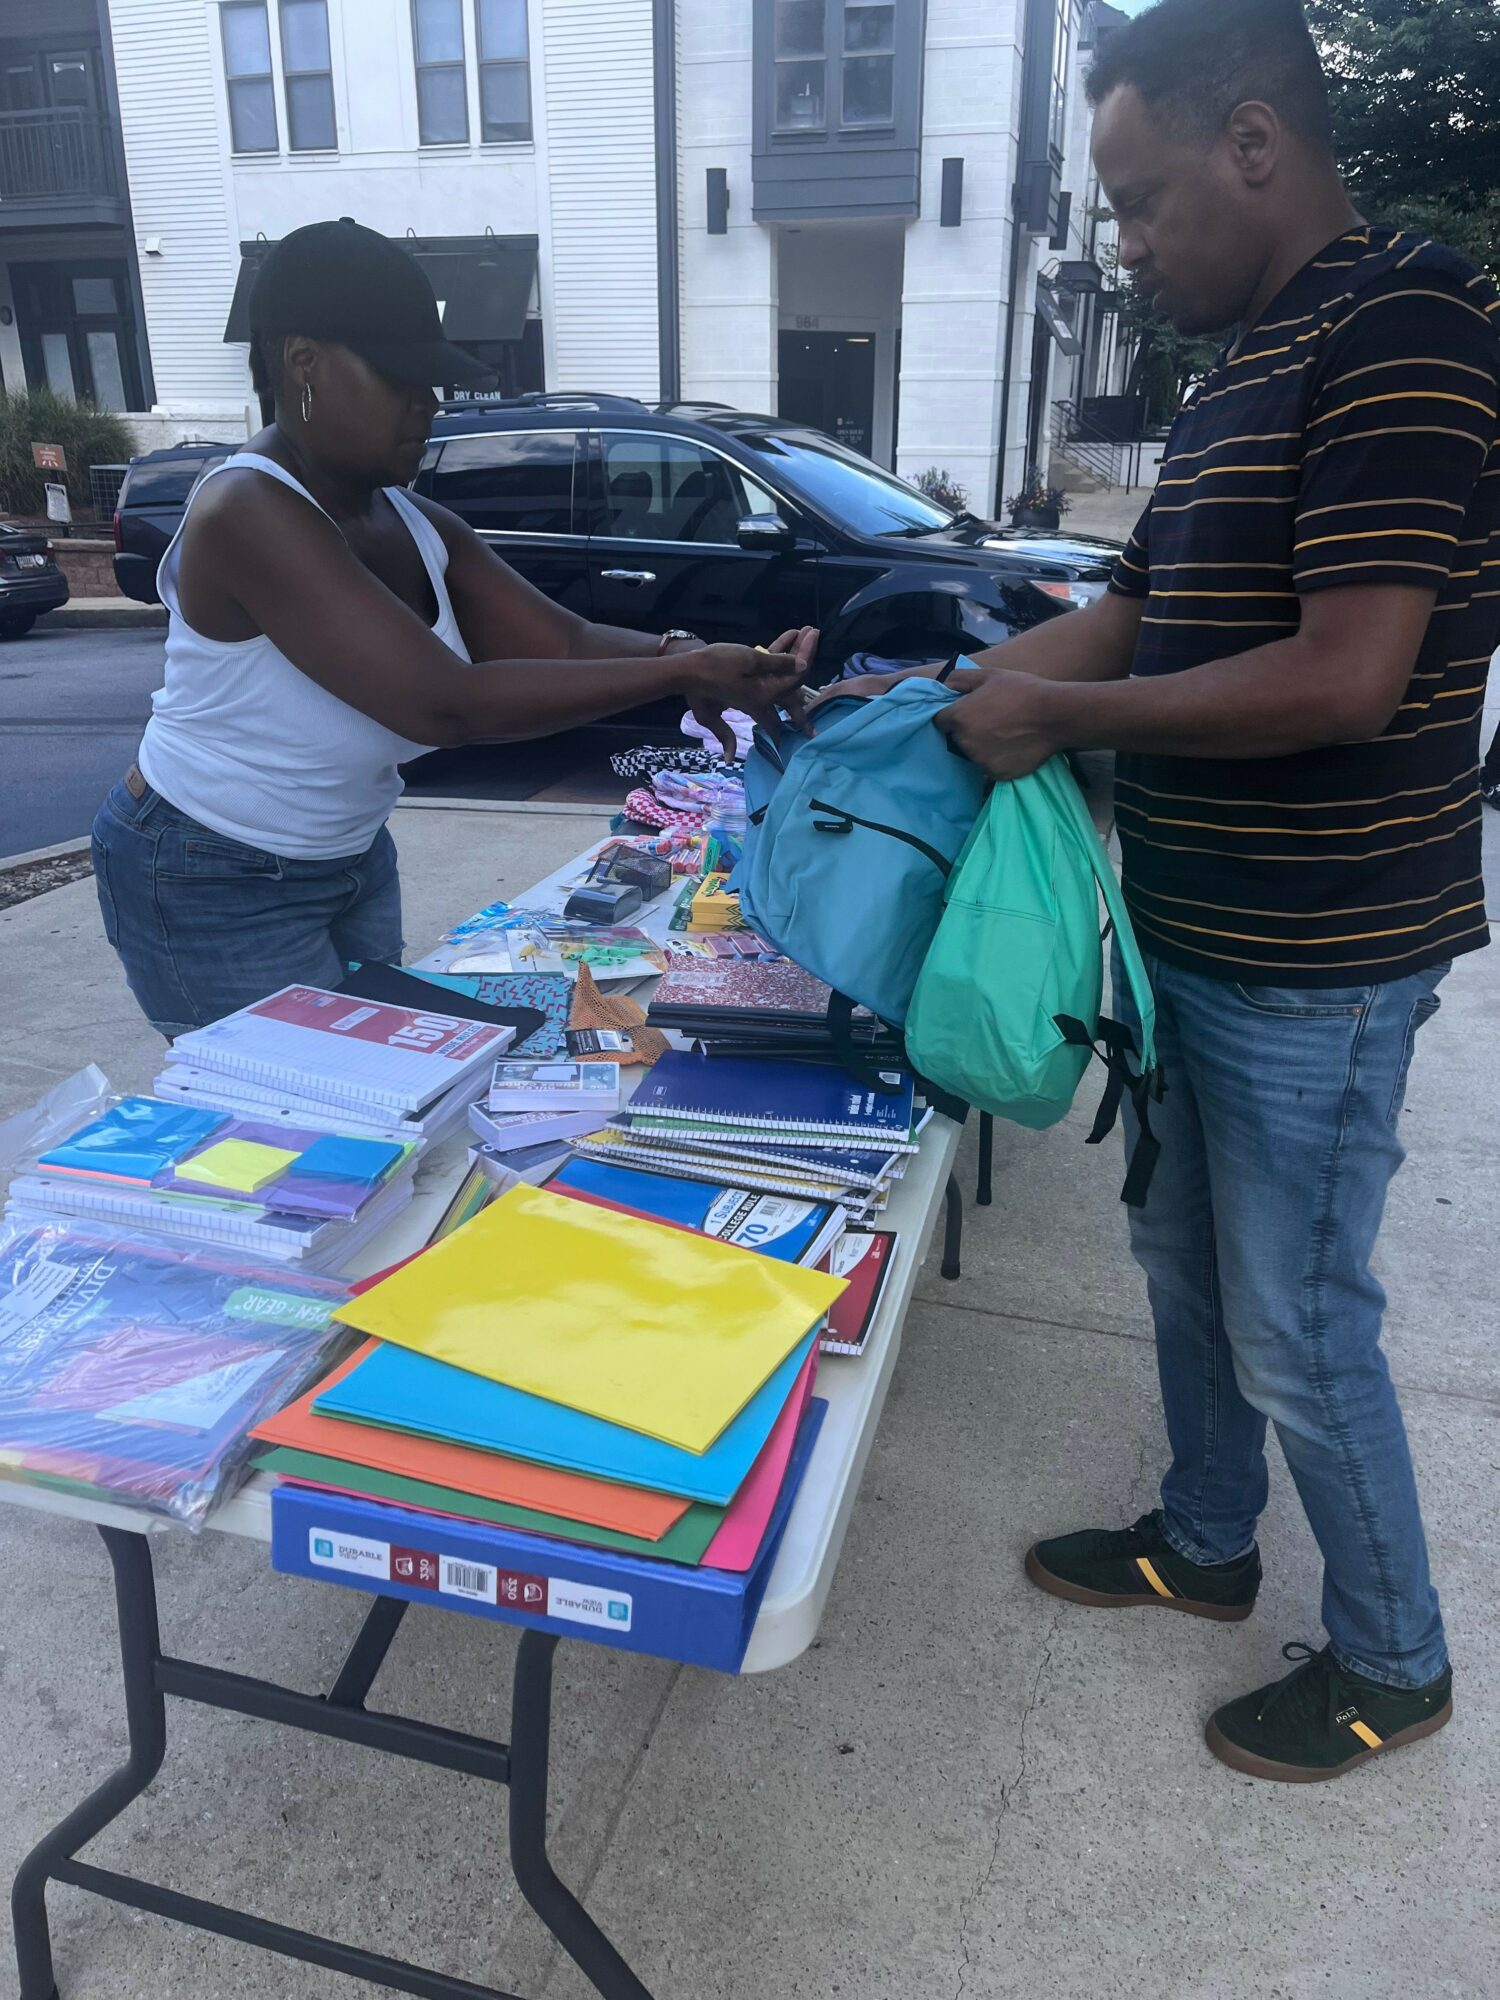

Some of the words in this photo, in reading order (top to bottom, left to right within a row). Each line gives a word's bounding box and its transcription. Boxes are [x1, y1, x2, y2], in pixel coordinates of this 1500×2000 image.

[453, 391, 470, 401] DRY
[474, 392, 501, 401] CLEAN
[388, 1016, 460, 1049] 150
[436, 1041, 459, 1055] WIDE
[459, 1025, 482, 1042] RULED
[742, 1194, 760, 1212] RULE
[735, 1223, 768, 1243] 70
[16, 1263, 118, 1350] DIVIDERS
[242, 1294, 288, 1315] GEAR
[295, 1304, 331, 1323] PEN
[338, 1545, 383, 1561] DURABLE
[508, 1577, 518, 1600] 330
[555, 1597, 603, 1614] DURABLE
[1335, 1709, 1357, 1724] Polo
